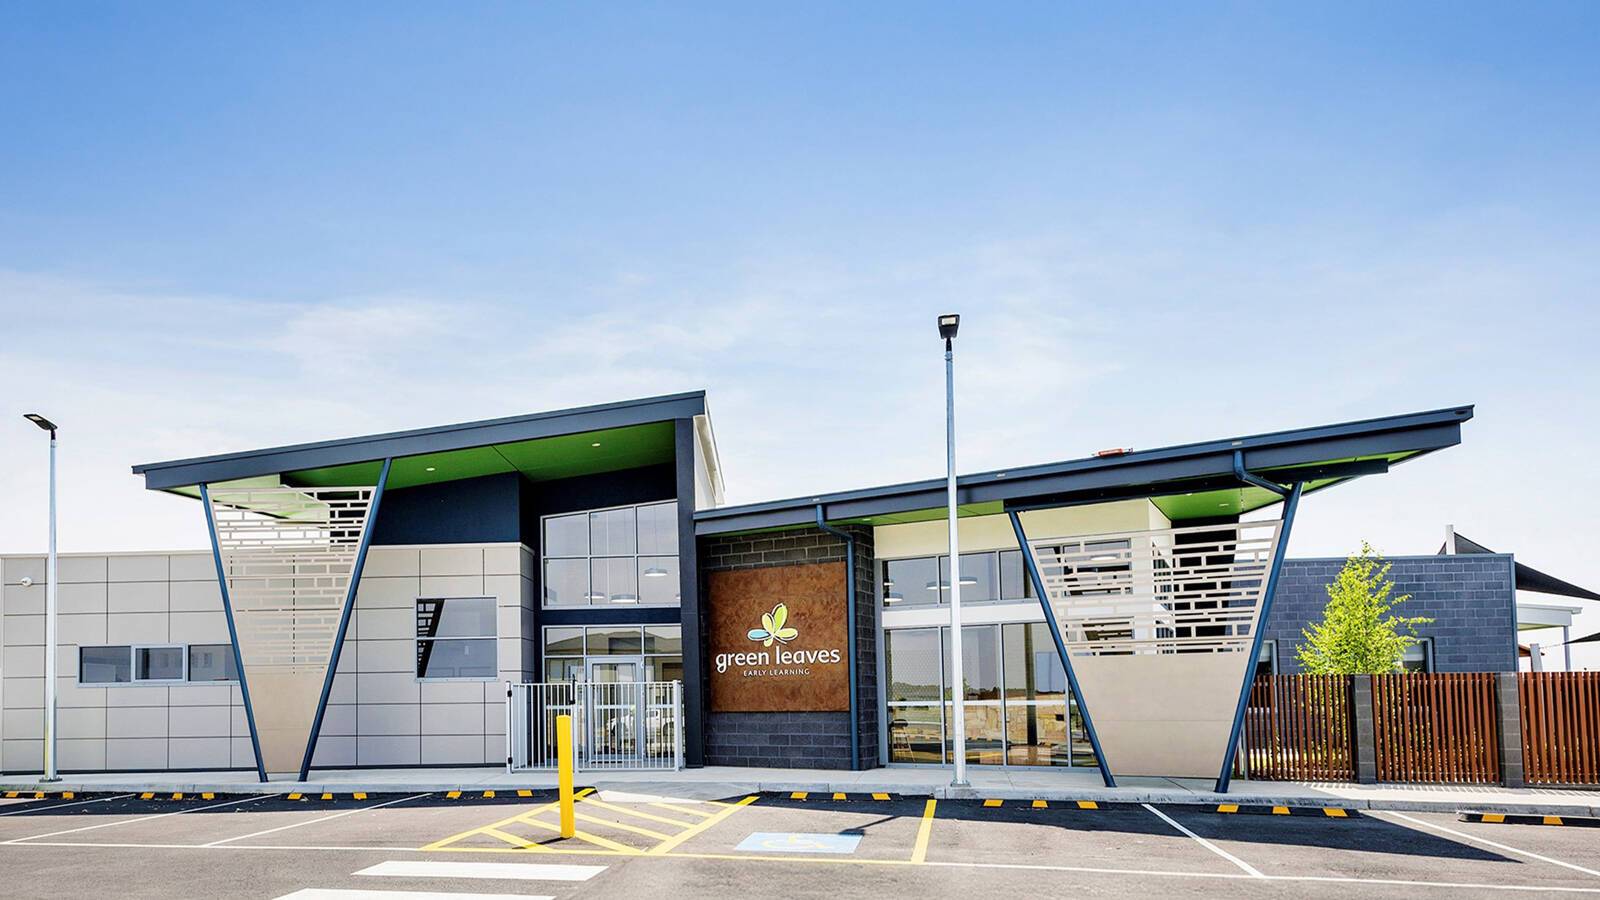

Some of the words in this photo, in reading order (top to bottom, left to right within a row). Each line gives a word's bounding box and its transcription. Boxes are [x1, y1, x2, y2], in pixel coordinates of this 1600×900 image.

[715, 651, 770, 674] green
[775, 645, 841, 665] leaves
[743, 669, 767, 677] EARLY
[769, 667, 811, 677] LEARNING
